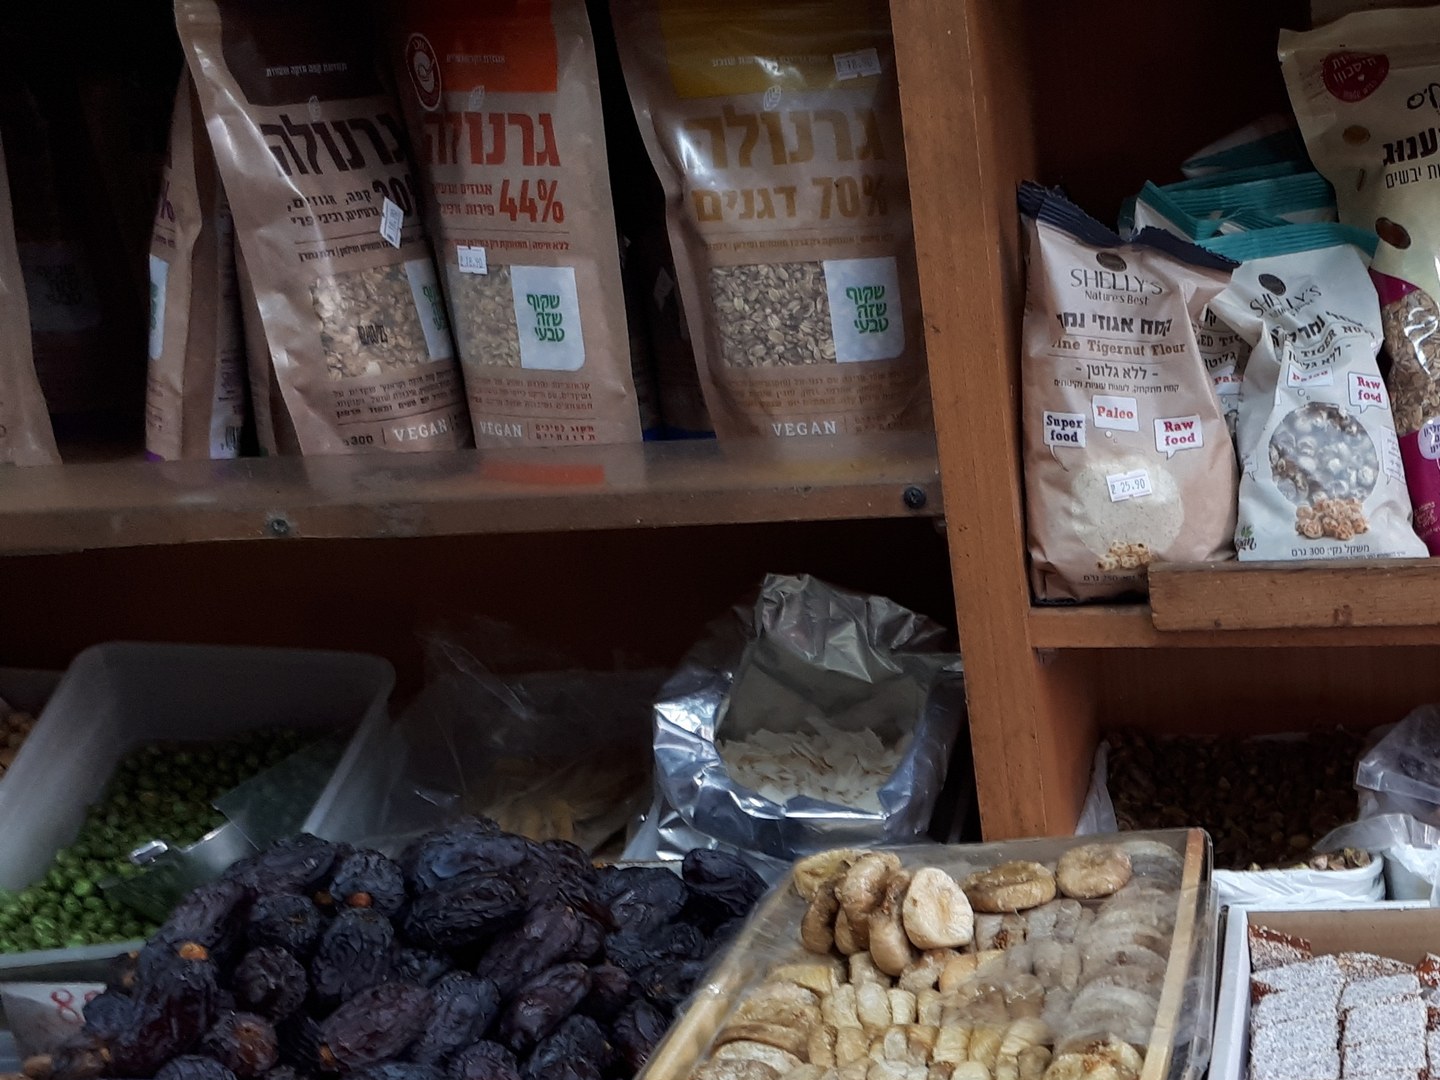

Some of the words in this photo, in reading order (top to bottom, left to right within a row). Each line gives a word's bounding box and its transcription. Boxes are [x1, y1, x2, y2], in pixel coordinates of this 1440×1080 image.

[259, 114, 403, 179] גרנולה
[421, 111, 561, 167] גרנולה
[1385, 167, 1421, 190] יבשים
[462, 184, 493, 196] אגוזים
[811, 175, 888, 220] 70%
[499, 178, 565, 225] 44%
[691, 186, 797, 223] דגנים
[526, 294, 560, 311] שקוף
[846, 285, 886, 304] שקוף
[1127, 291, 1150, 306] Best
[857, 303, 887, 318] שזה
[536, 311, 563, 328] שזה
[854, 318, 890, 334] טבעי
[1092, 313, 1134, 333] אגוזי
[1140, 318, 1173, 337] קמח
[534, 327, 565, 343] טבעי
[1300, 329, 1338, 357] TIGER
[1087, 339, 1145, 357] Tigernut
[1151, 343, 1186, 357] Flour
[1087, 364, 1121, 380] גלוטן
[1122, 365, 1148, 379] ללא
[1357, 377, 1381, 390] Raw
[1358, 390, 1382, 403] food
[1096, 405, 1134, 420] Paleo
[479, 421, 523, 438] VEGAN
[771, 420, 838, 437] VEGAN
[1046, 415, 1083, 430] Super
[1164, 420, 1194, 432] Raw
[393, 420, 449, 442] VEGAN
[1050, 429, 1079, 443] food
[1165, 433, 1196, 446] food
[1291, 546, 1307, 557] גרם
[1309, 546, 1325, 556] 300
[1343, 543, 1370, 554] משקל
